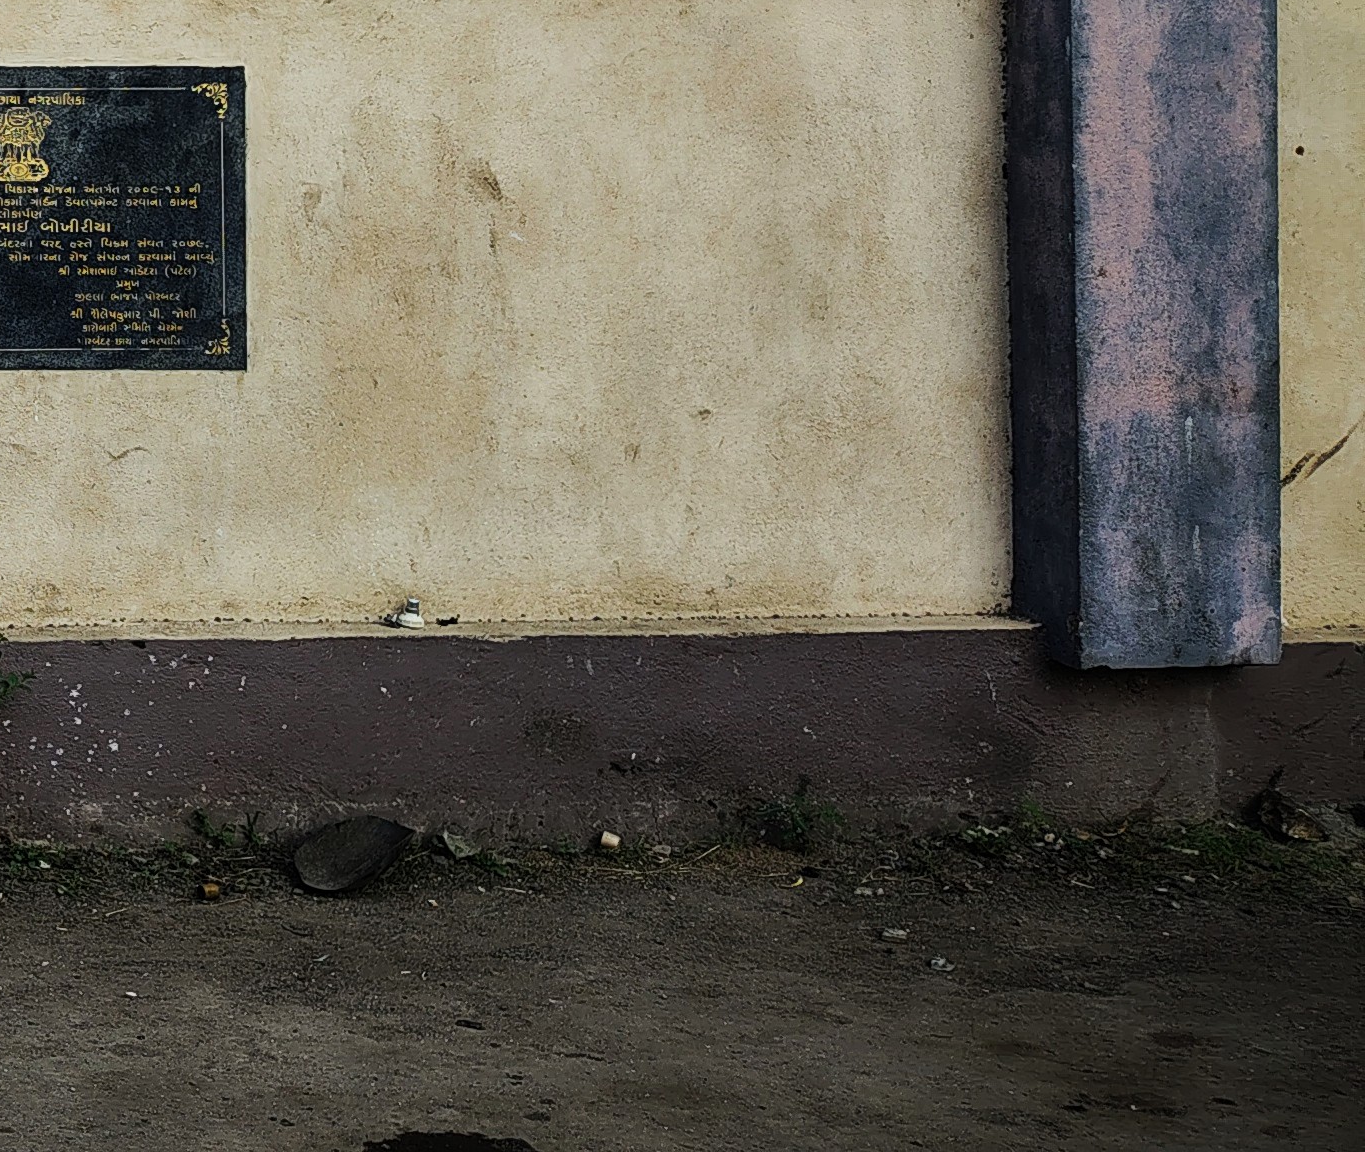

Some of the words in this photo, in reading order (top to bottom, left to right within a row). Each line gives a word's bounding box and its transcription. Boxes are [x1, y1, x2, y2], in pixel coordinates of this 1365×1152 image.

[28, 92, 87, 106] નગરપાલિકા
[3, 183, 39, 194] વિકાસ
[43, 183, 77, 194] યોજના
[83, 183, 121, 194] અંતર્ગત
[188, 182, 202, 193] ની
[29, 196, 58, 207] ગાર્ડન
[65, 196, 119, 207] ડેવલપમેન્ટ
[125, 198, 163, 207] કરવાના
[169, 196, 199, 209] કામનું
[40, 217, 112, 233] બોખીરીયા
[69, 238, 93, 249] હસ્તે
[100, 237, 130, 248] વિક્રમ
[136, 237, 165, 248] સંવત
[8, 251, 62, 262] સોમારના
[68, 251, 89, 262] રોજ
[96, 251, 131, 262] સંપન્ન
[138, 251, 177, 261] કરવામાં
[57, 265, 71, 276] શ્રી
[164, 264, 199, 277] (પટેલ)
[115, 280, 140, 291] પ્રમુખ
[110, 293, 139, 301] ભાજપ
[69, 307, 84, 319] શ્રી
[171, 307, 197, 318] જોશી
[81, 322, 118, 332] કારોબારી
